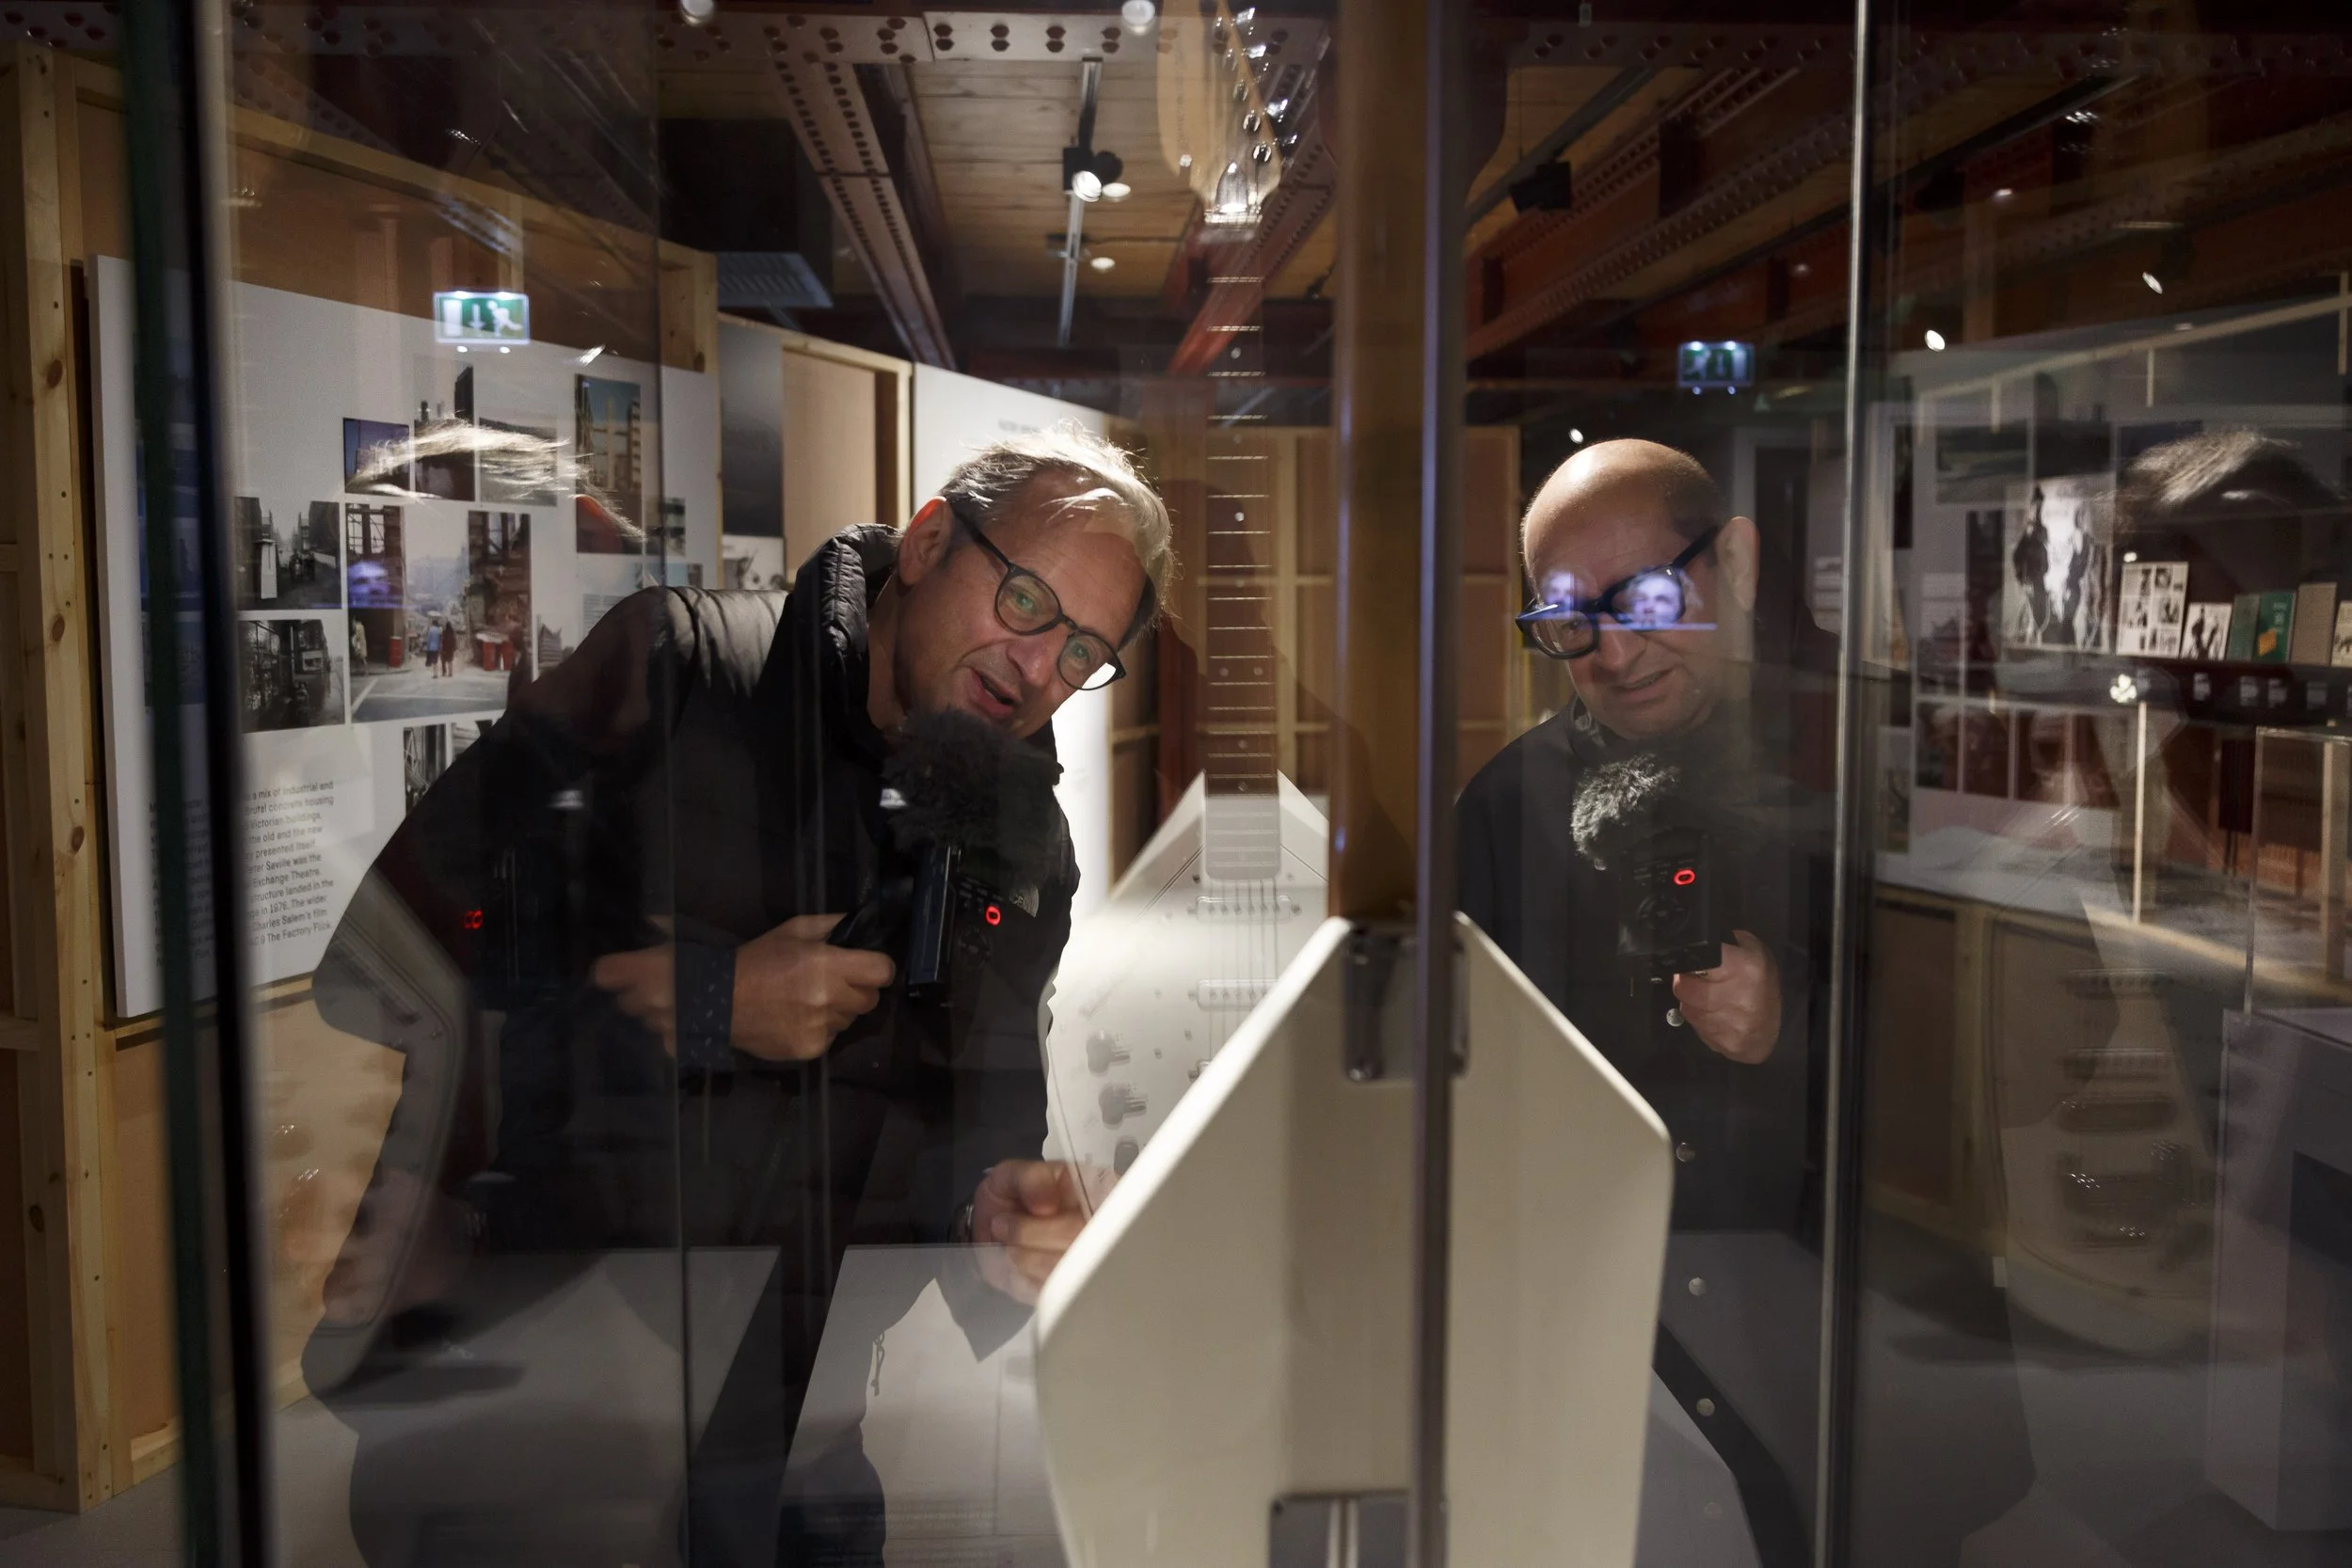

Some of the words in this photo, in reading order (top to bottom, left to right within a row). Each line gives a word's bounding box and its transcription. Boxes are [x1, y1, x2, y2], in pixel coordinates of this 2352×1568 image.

[258, 788, 272, 799] mix
[282, 782, 319, 796] industrial
[319, 781, 334, 791] and
[262, 831, 275, 843] old
[277, 830, 292, 840] and
[293, 827, 306, 837] the
[307, 826, 323, 834] new
[255, 843, 294, 859] presented
[265, 857, 292, 871] Saville
[293, 856, 308, 865] was
[309, 853, 322, 863] the
[252, 873, 289, 888] Exchange
[285, 882, 311, 895] landed
[313, 880, 321, 891] in
[321, 879, 334, 888] the
[261, 906, 268, 915] in
[292, 897, 305, 909] The
[306, 894, 328, 905] wider
[252, 918, 280, 931] Charles
[313, 909, 328, 919] film
[267, 932, 281, 943] The
[282, 927, 311, 940] Factory
